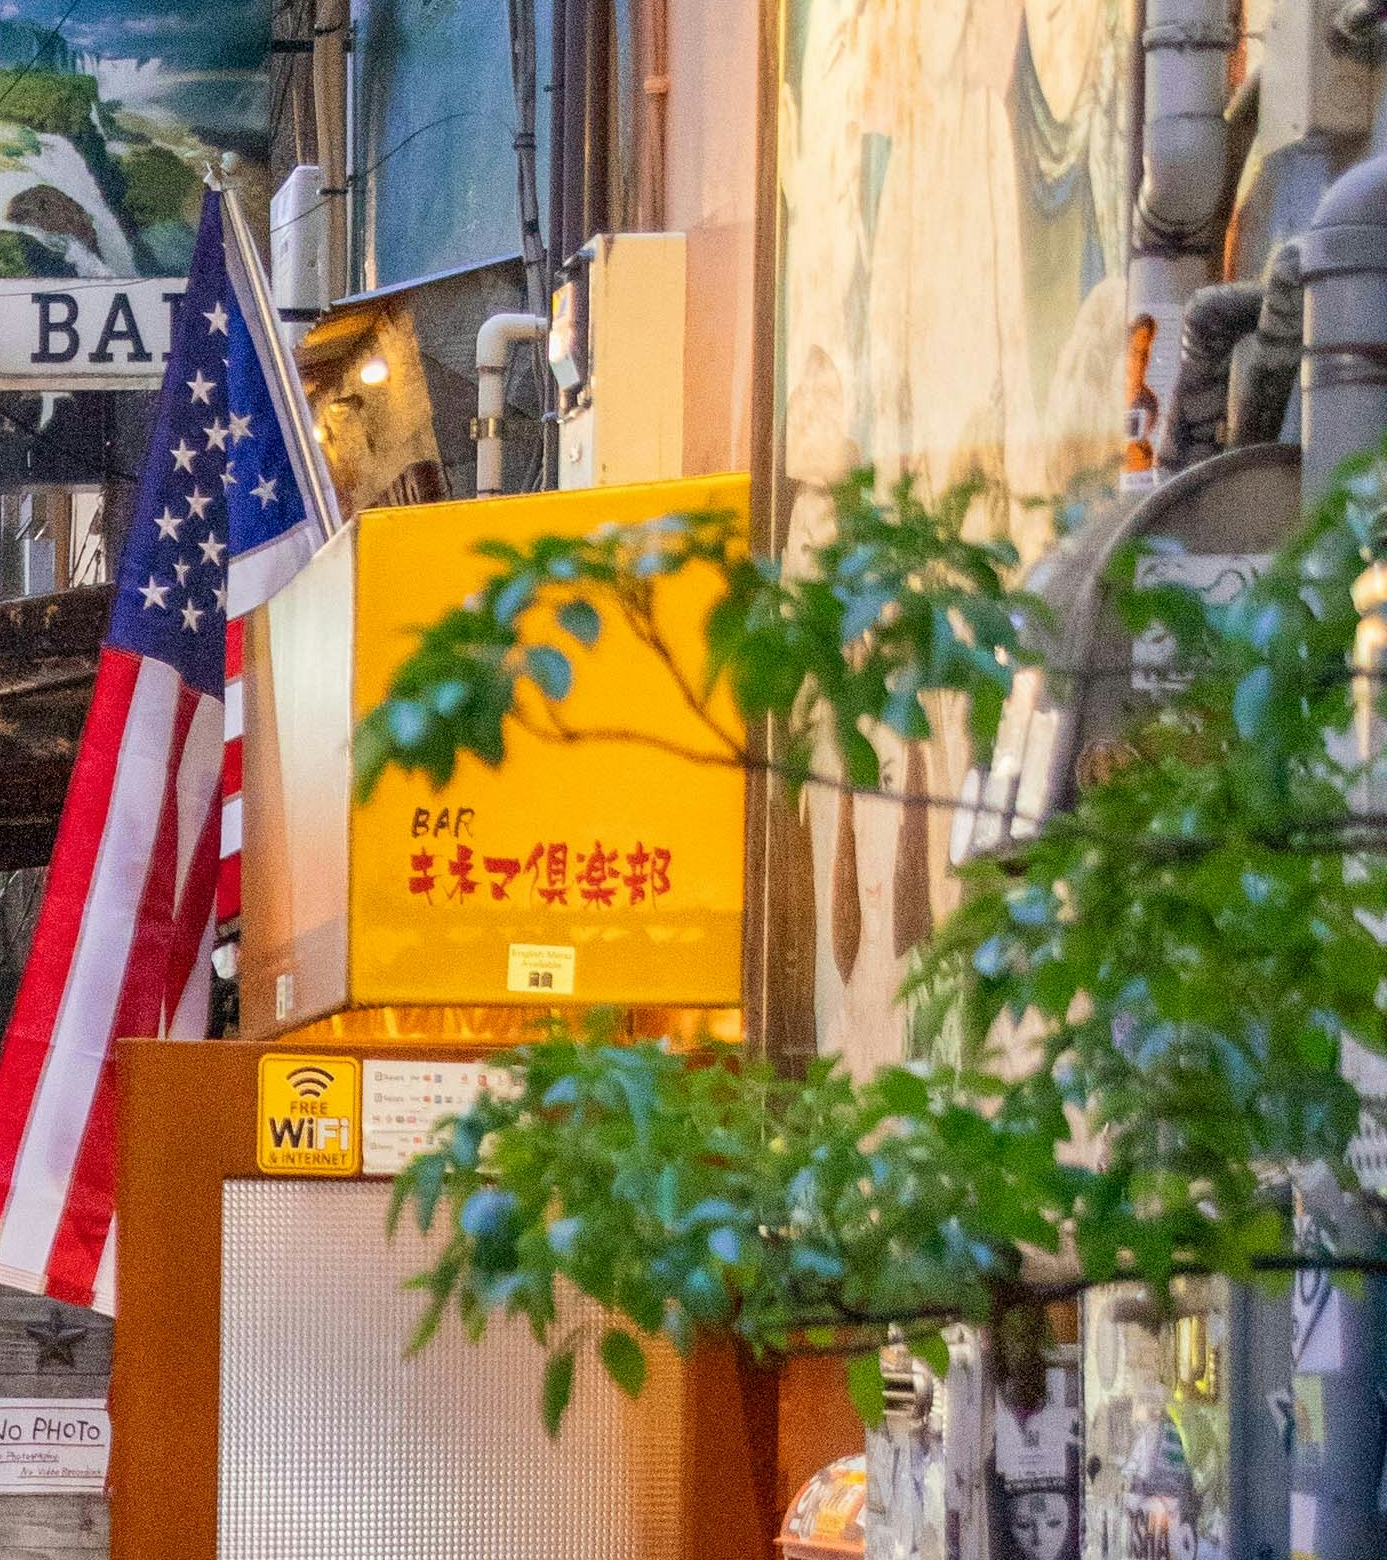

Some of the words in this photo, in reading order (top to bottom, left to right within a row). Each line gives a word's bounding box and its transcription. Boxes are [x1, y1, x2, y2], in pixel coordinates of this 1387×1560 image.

[411, 807, 475, 839] BAR
[408, 843, 672, 910] キネマ倶楽部
[290, 1101, 328, 1115] FREE
[269, 1117, 350, 1150] WiFi
[282, 1152, 348, 1166] INTERNET
